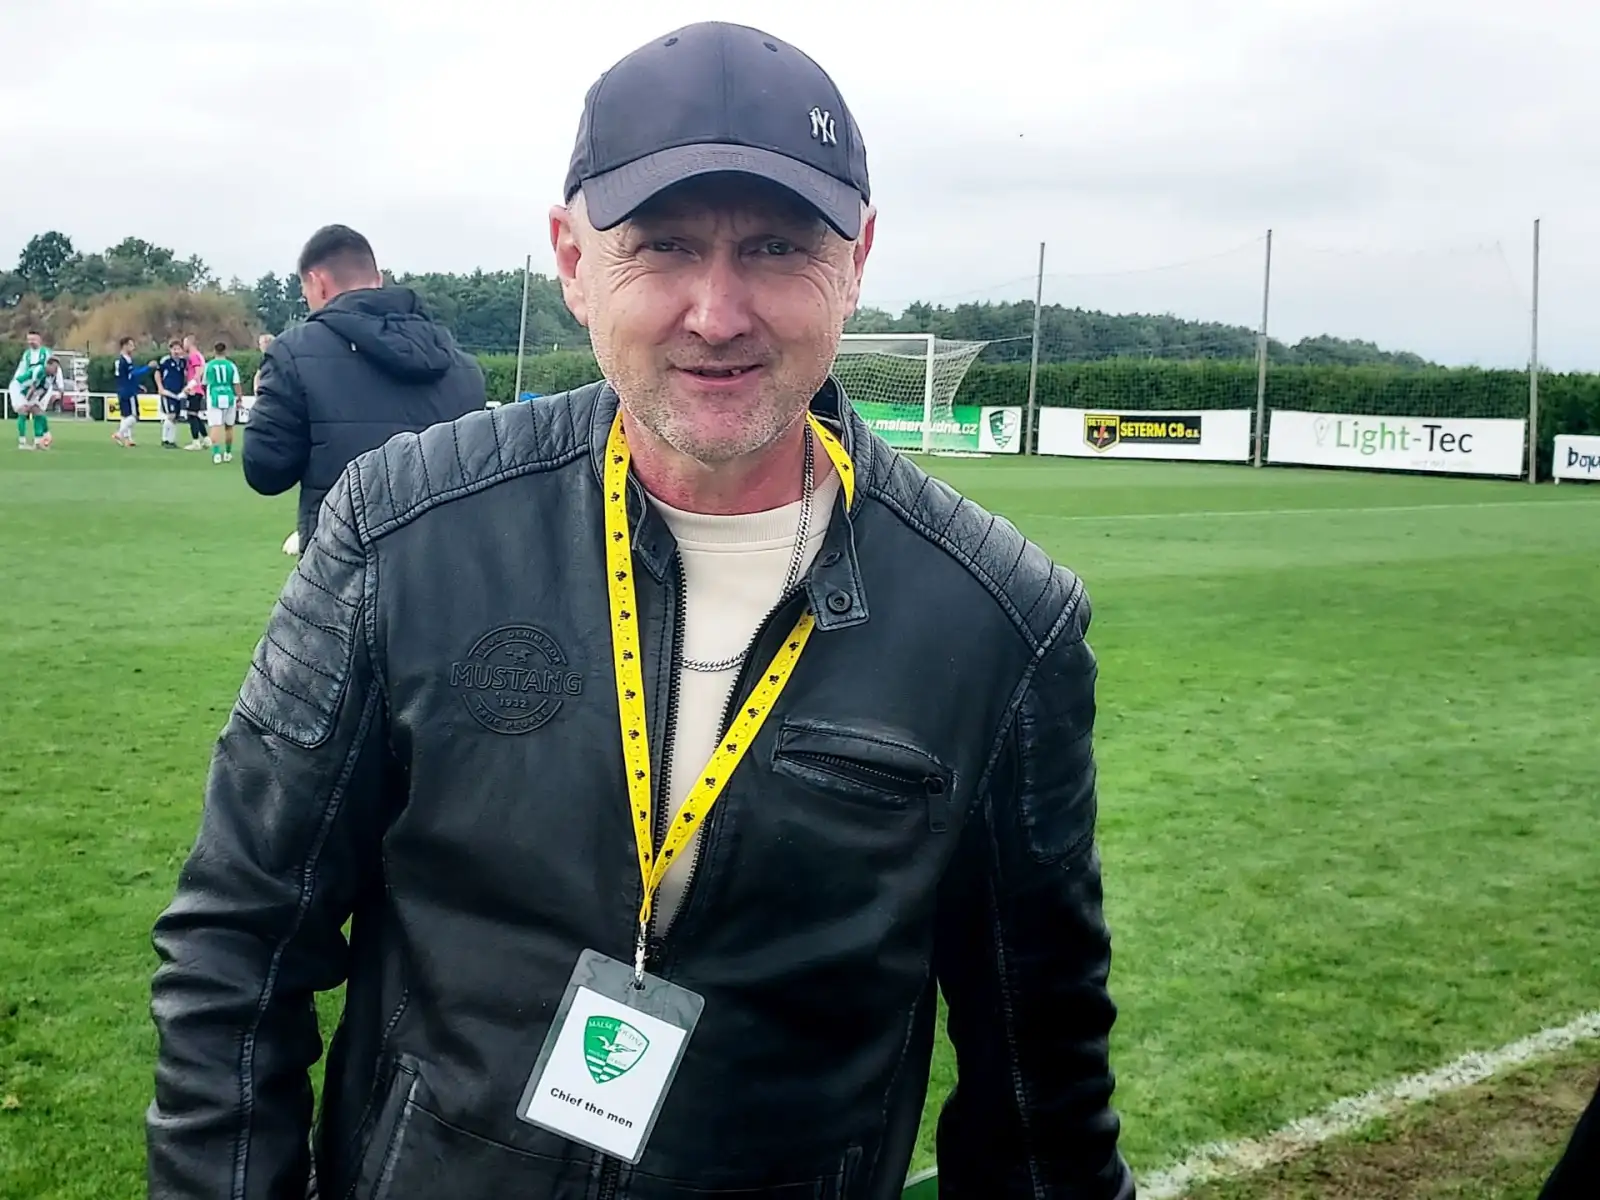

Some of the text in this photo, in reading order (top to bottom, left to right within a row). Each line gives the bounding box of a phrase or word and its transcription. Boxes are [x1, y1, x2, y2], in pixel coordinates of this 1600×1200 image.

[213, 364, 228, 383] 11
[1120, 422, 1167, 438] SETERM
[1168, 422, 1185, 438] CB
[1336, 420, 1473, 456] Light-Tec
[450, 661, 583, 696] MUSTANG
[500, 697, 528, 708] 1932
[550, 1087, 633, 1129] Chief the men
